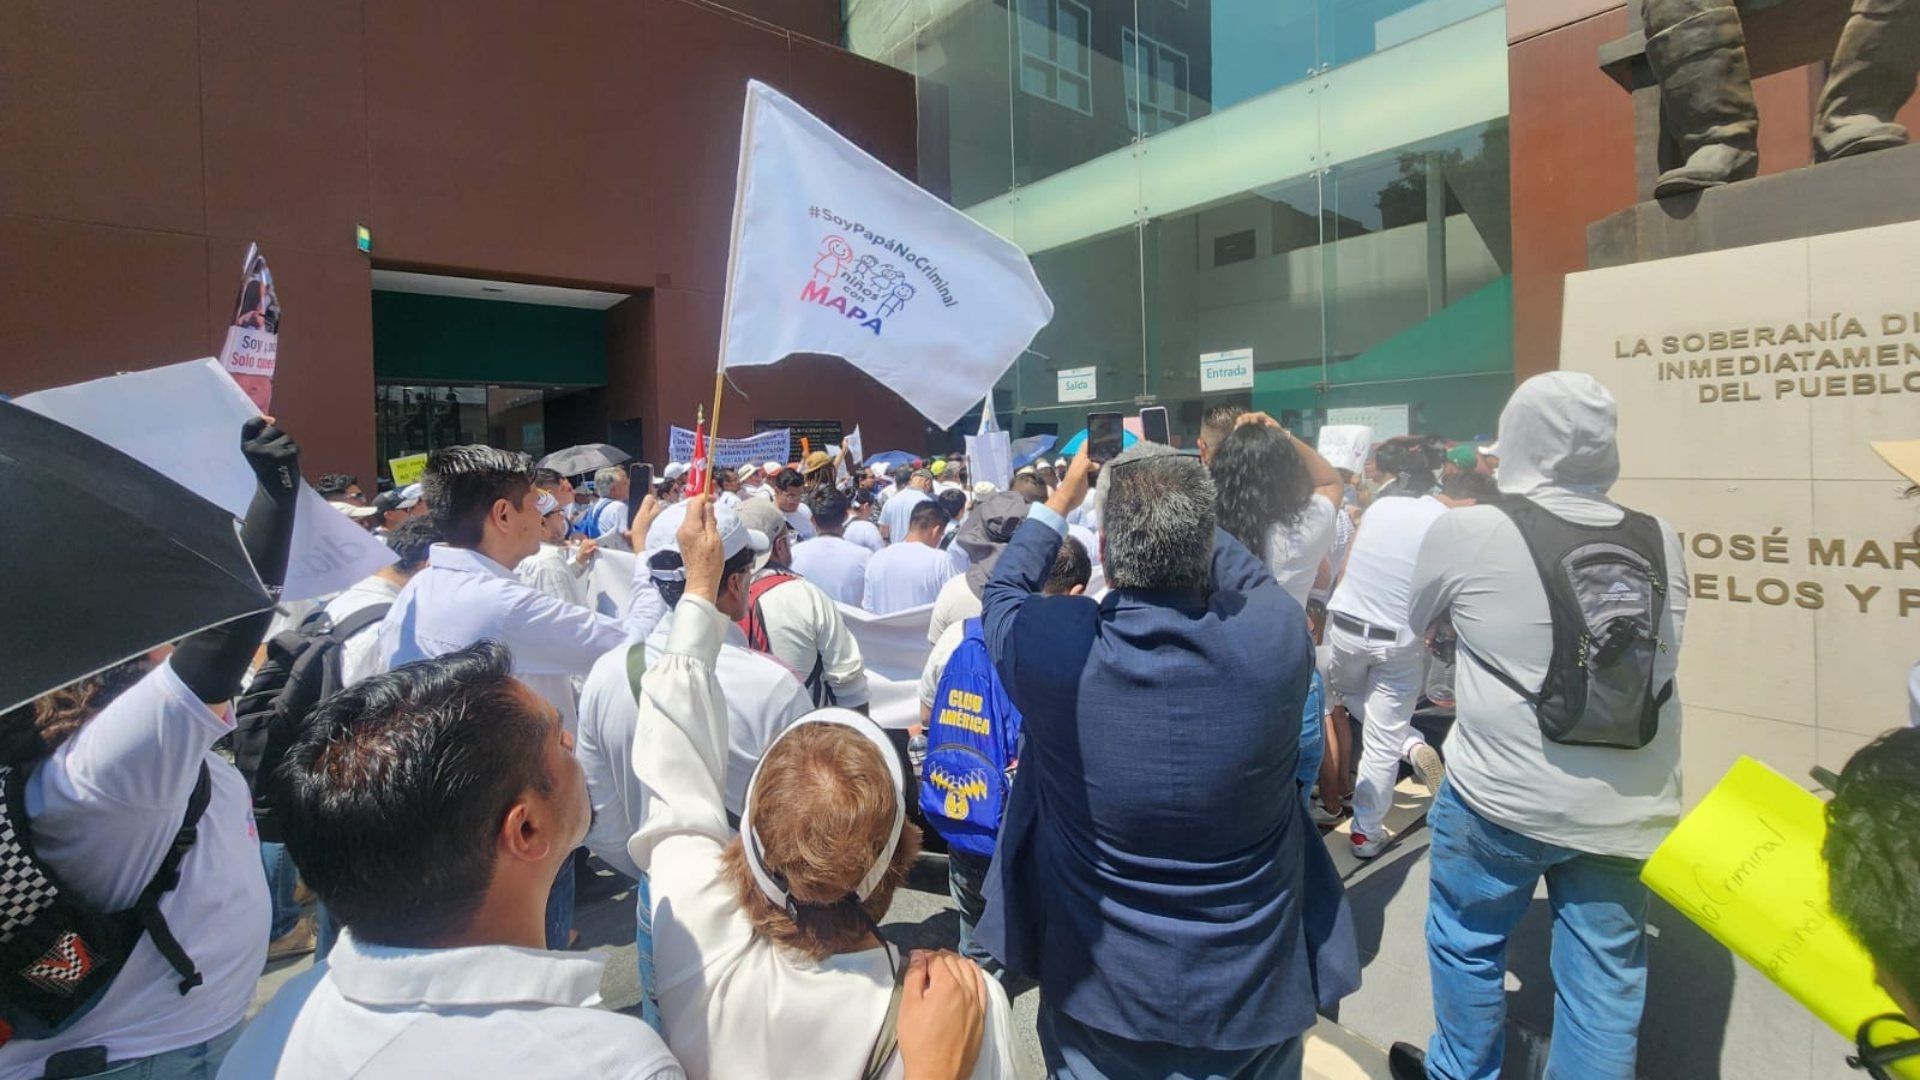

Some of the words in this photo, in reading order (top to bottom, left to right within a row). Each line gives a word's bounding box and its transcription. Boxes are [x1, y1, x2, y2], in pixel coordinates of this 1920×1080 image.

[808, 205, 959, 308] #SoyPapáNoCriminal
[840, 270, 879, 301] niños
[843, 285, 866, 303] con
[801, 280, 882, 336] MAPA
[242, 335, 263, 353] Soy
[1615, 338, 1652, 359] LA
[1661, 312, 1867, 355] SOBERANÍA
[231, 352, 255, 369] Solo
[1206, 365, 1247, 379] Entrada
[1065, 379, 1089, 391] Salida
[1699, 381, 1762, 404] DEL
[1678, 527, 1790, 563] OSÉ
[1689, 573, 1825, 610] ELOS
[1844, 584, 1881, 613] Y
[949, 689, 983, 713] CLUB
[939, 708, 990, 736] AMÉRICA
[1692, 815, 1786, 907] Criminal
